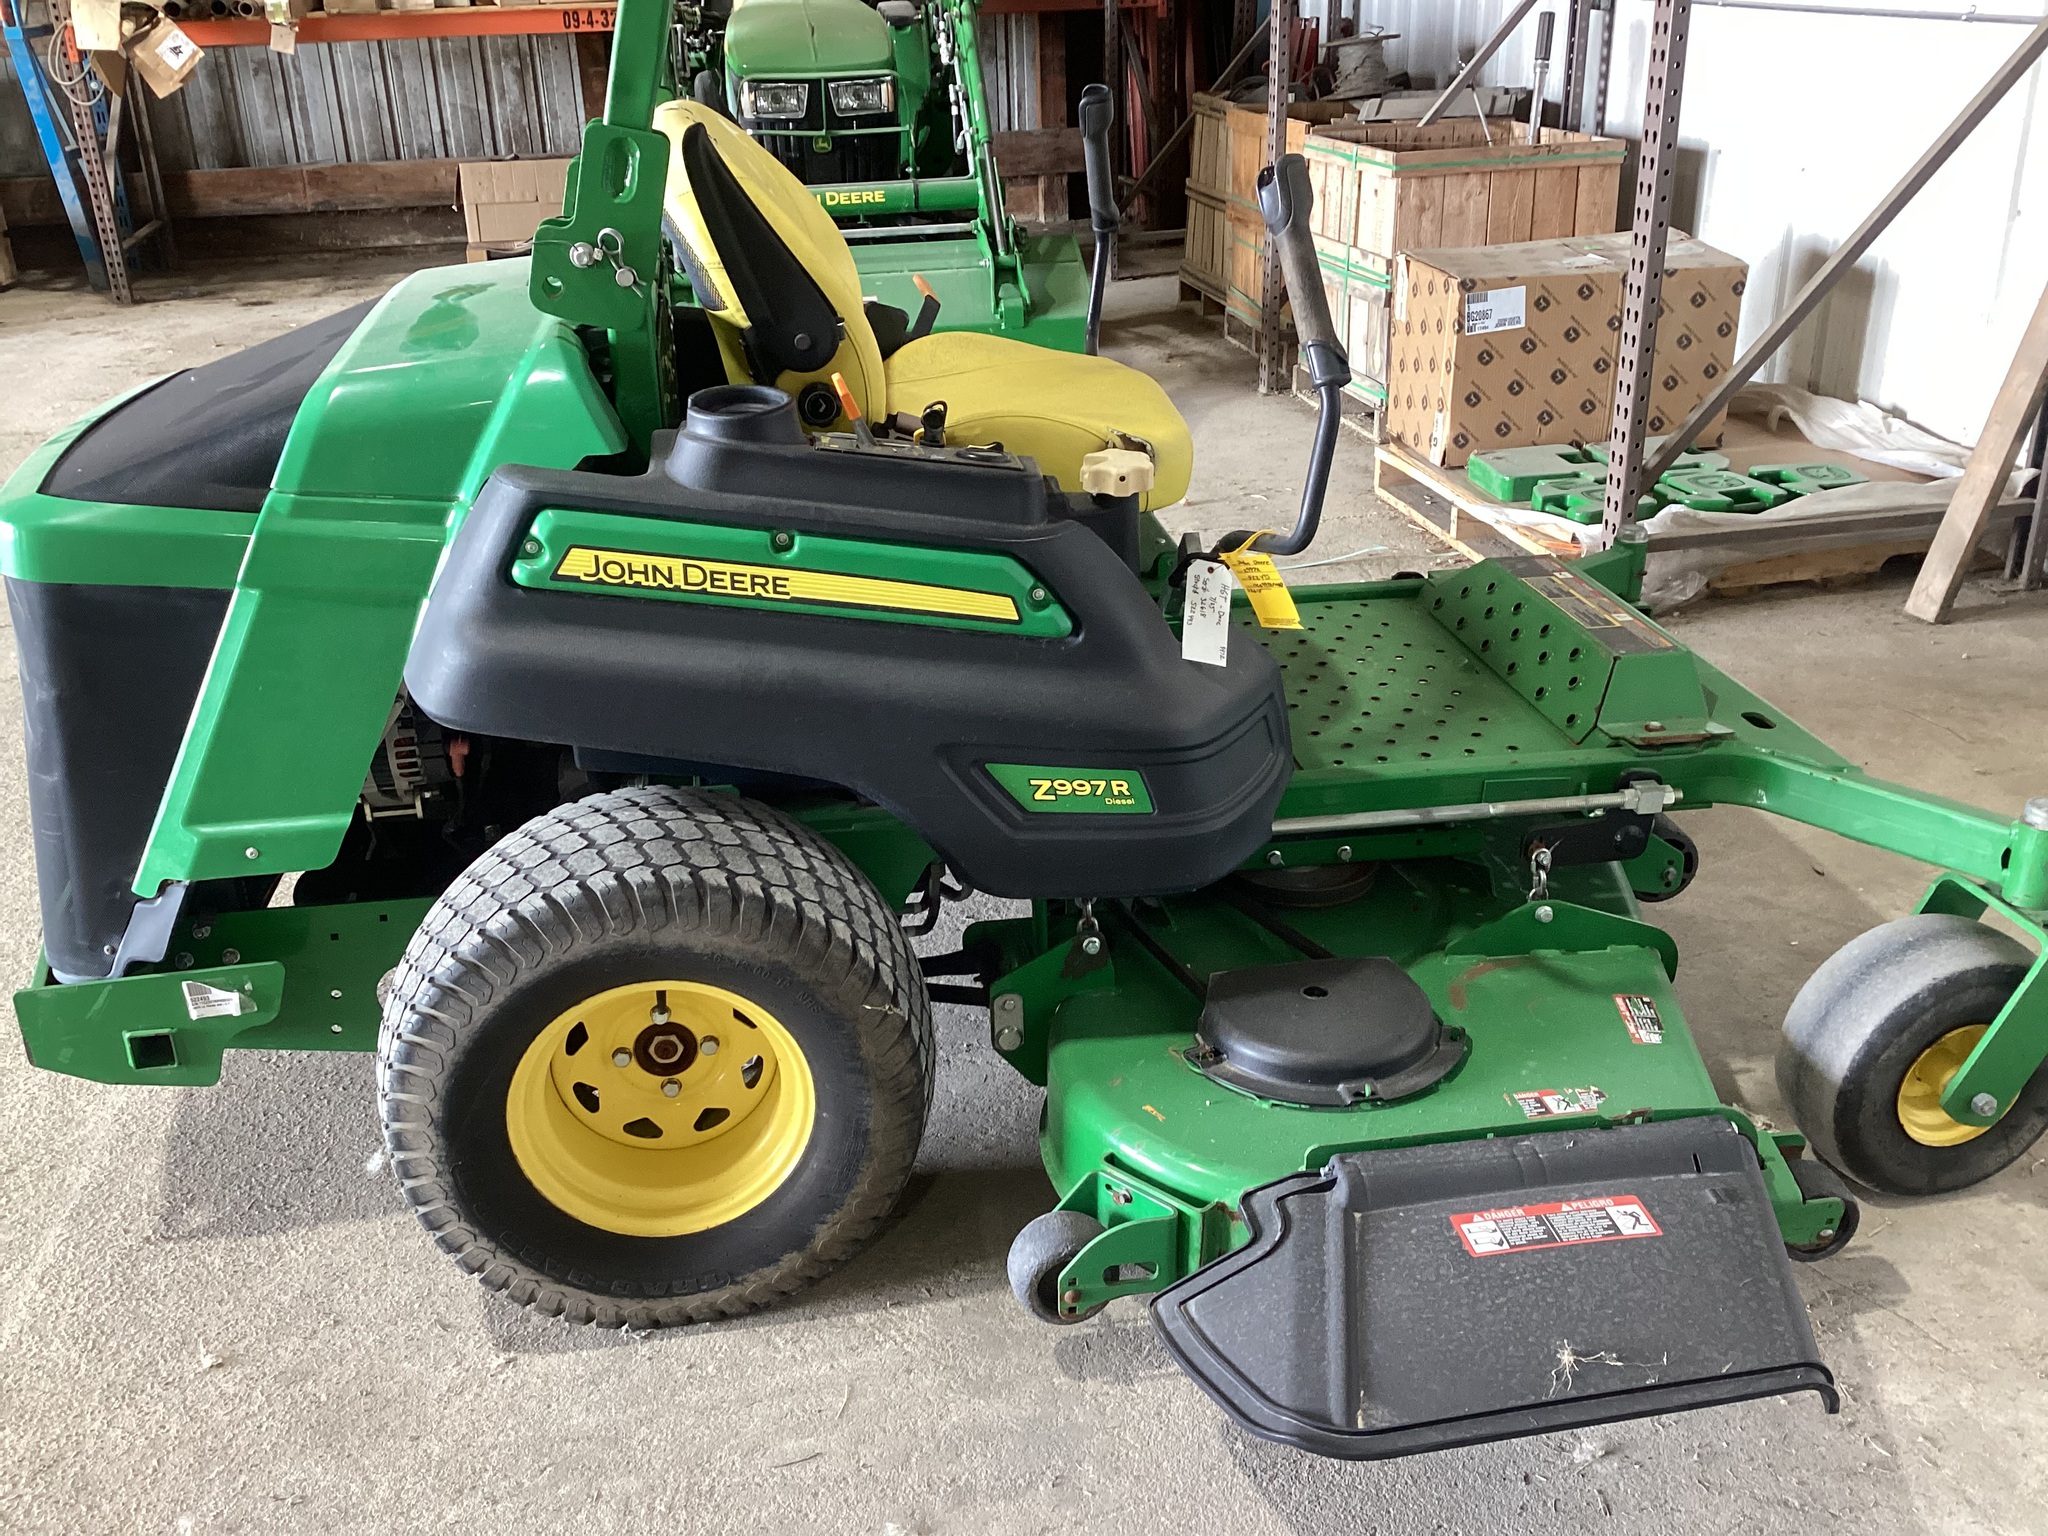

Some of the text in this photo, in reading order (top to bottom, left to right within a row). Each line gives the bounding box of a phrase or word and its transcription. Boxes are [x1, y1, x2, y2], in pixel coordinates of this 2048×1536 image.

[825, 190, 886, 206] DEERE
[1467, 309, 1493, 322] BG20867
[583, 555, 790, 596] JOHN DEERE
[1029, 779, 1131, 801] Z997R
[1483, 1198, 1615, 1220] DANGER PELIGRO
